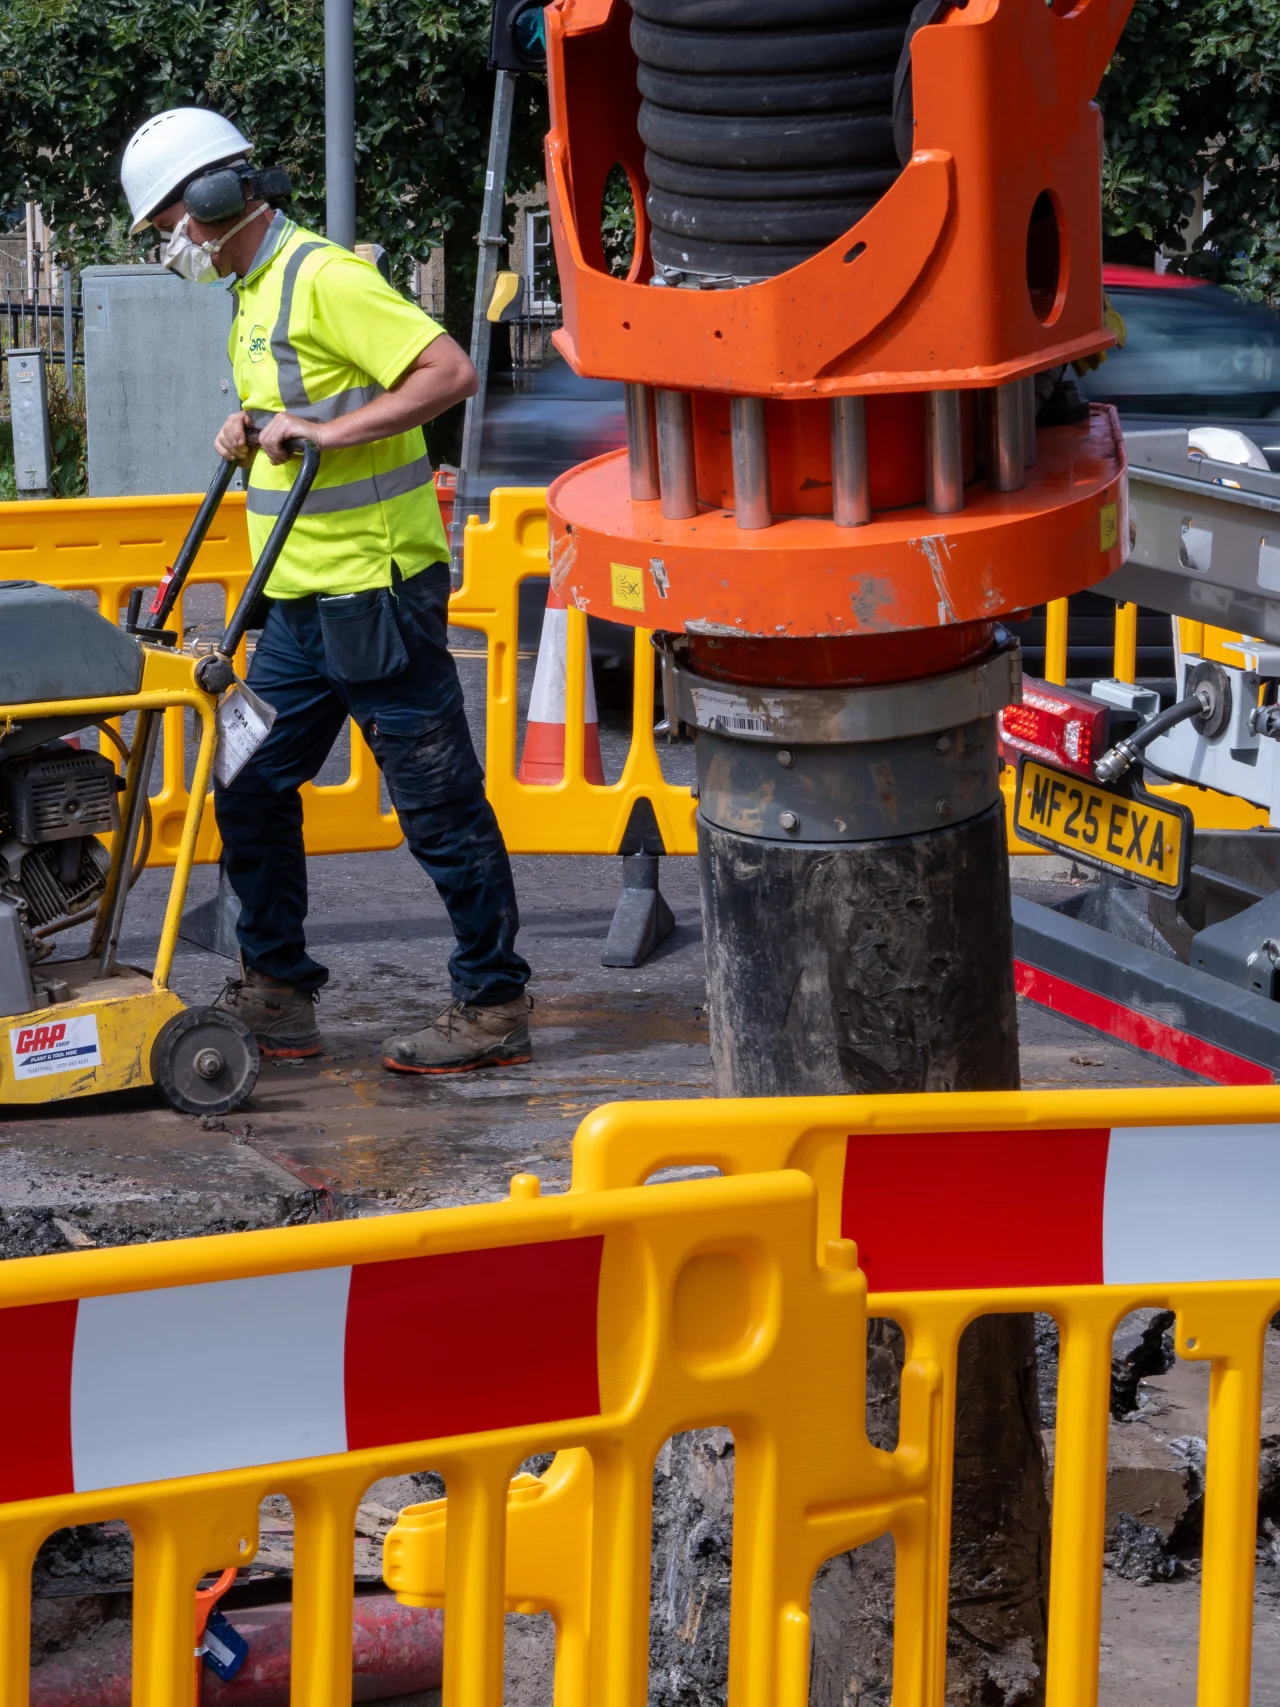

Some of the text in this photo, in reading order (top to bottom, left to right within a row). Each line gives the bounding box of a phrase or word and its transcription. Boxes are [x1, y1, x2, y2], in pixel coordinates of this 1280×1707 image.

[250, 337, 267, 351] GRS
[1029, 773, 1164, 871] MF25 EXA
[16, 1023, 71, 1054] GAP GROUP
[30, 1055, 47, 1063] PLANT
[52, 1051, 65, 1059] TOOL
